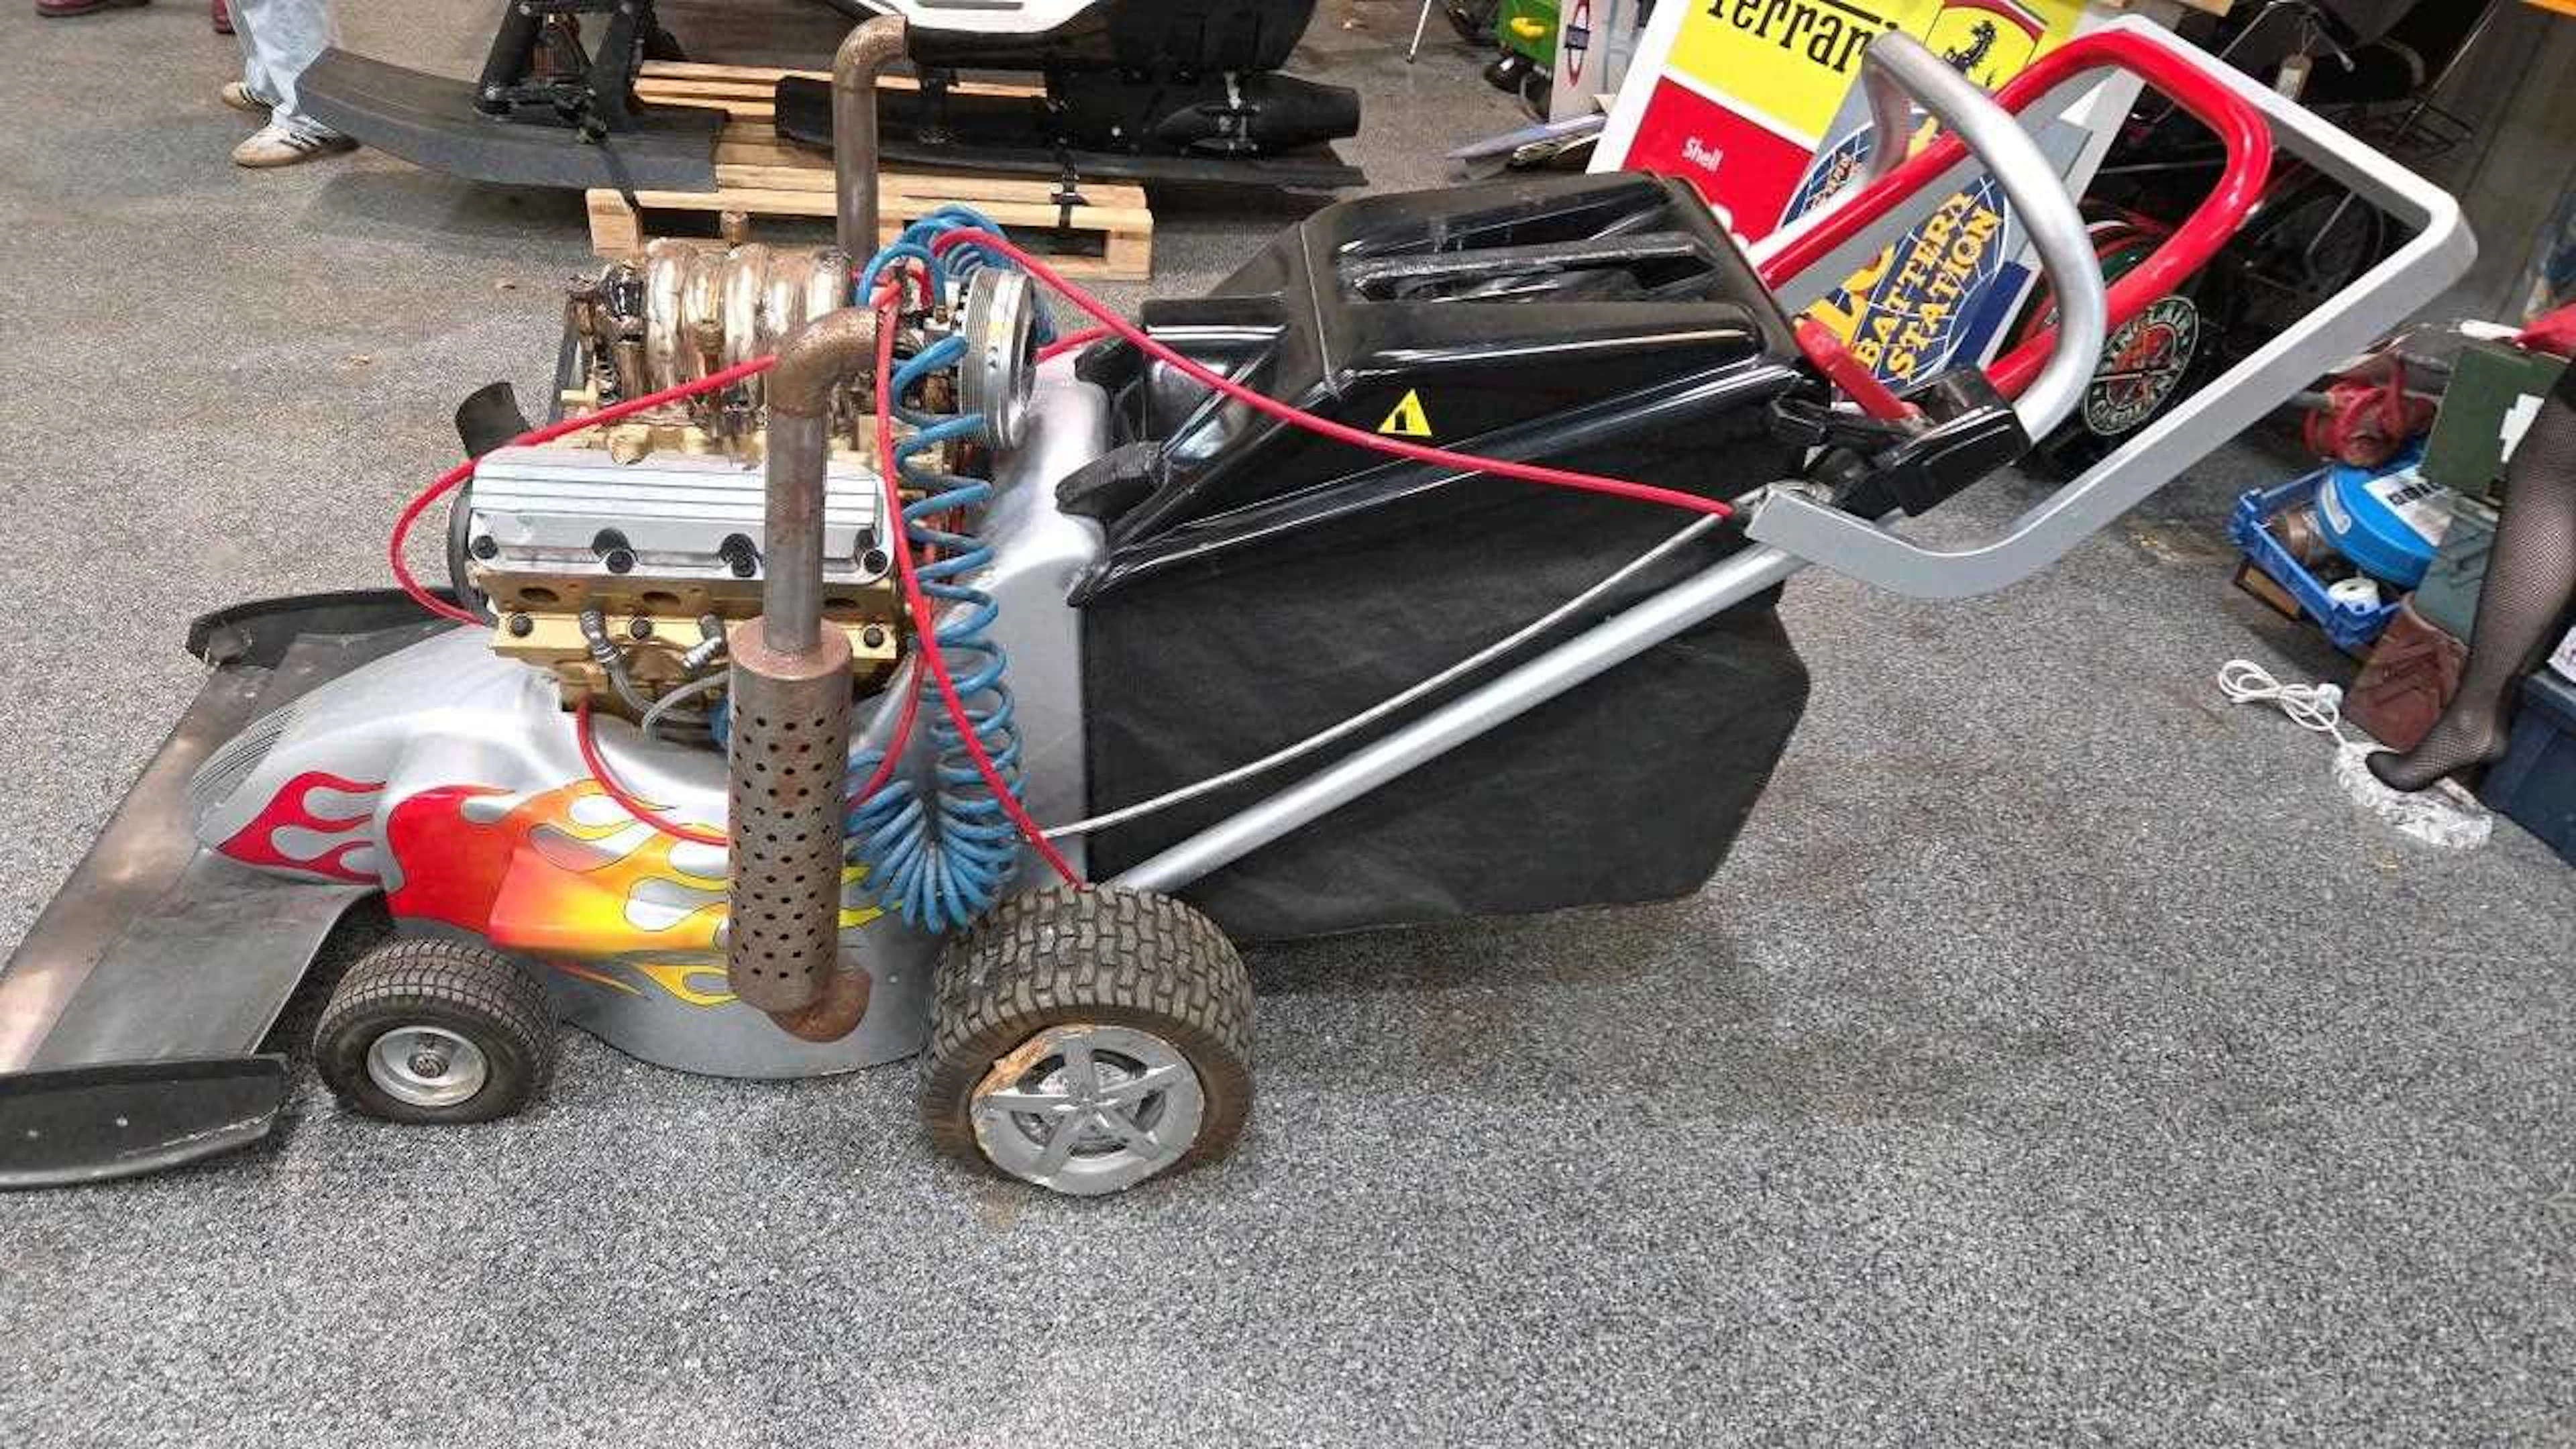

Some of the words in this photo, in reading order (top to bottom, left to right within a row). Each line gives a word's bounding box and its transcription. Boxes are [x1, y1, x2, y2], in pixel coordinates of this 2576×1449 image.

[1706, 0, 1898, 72] errar
[1681, 136, 1725, 172] Shell
[1887, 205, 2002, 380] STATION
